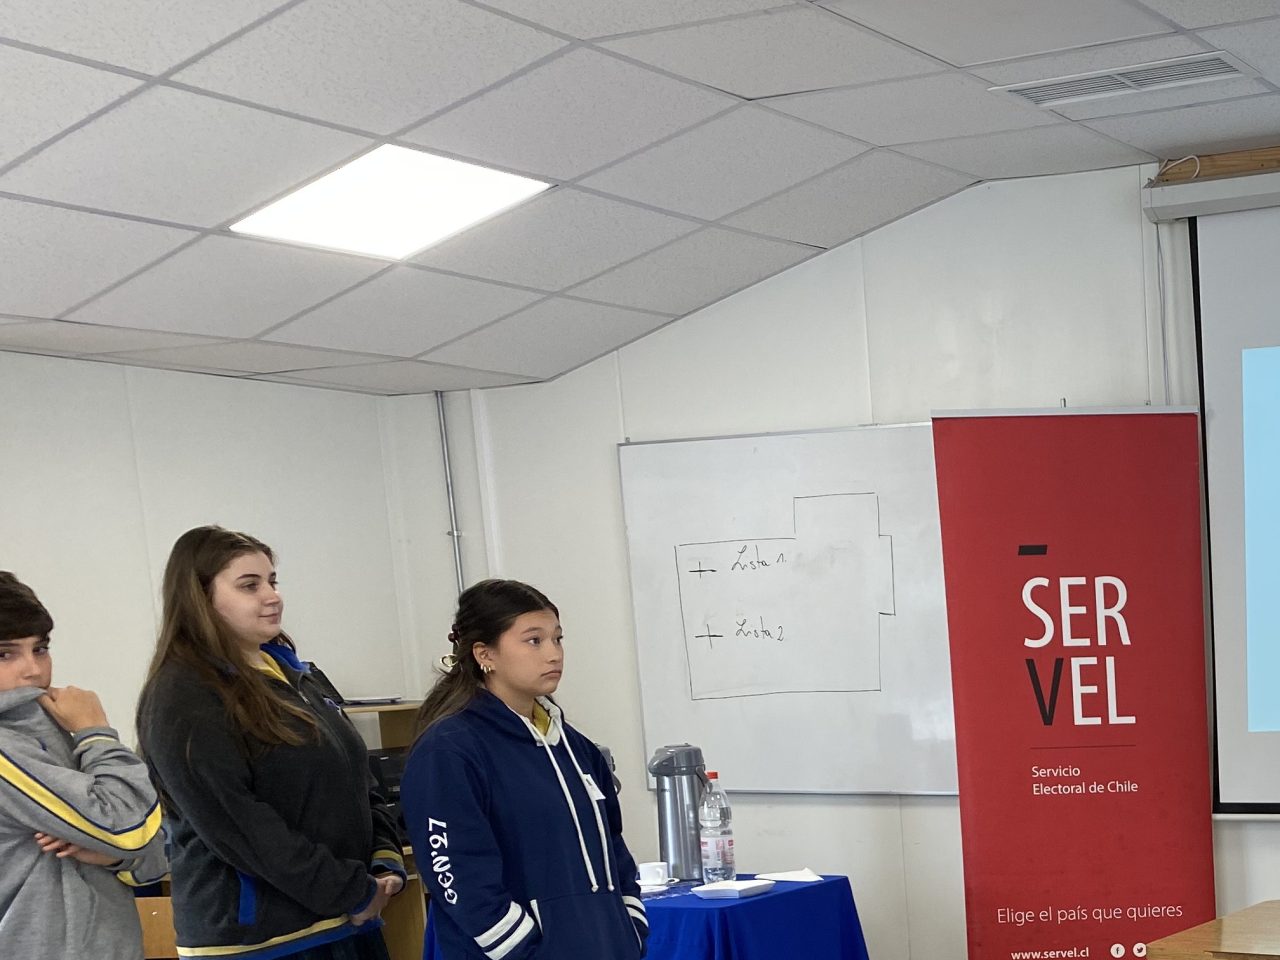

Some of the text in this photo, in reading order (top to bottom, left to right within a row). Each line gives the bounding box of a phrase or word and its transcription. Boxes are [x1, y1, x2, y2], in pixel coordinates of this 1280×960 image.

[731, 544, 770, 571] Lista
[1021, 575, 1132, 648] SER
[735, 616, 785, 642] Lista 2
[1025, 656, 1136, 726] VEL
[1031, 765, 1081, 778] Servicio
[1032, 780, 1139, 795] Electoral de Chile
[996, 903, 1183, 926] Elige el país que quieres
[1011, 946, 1089, 960] www.servel.cl
